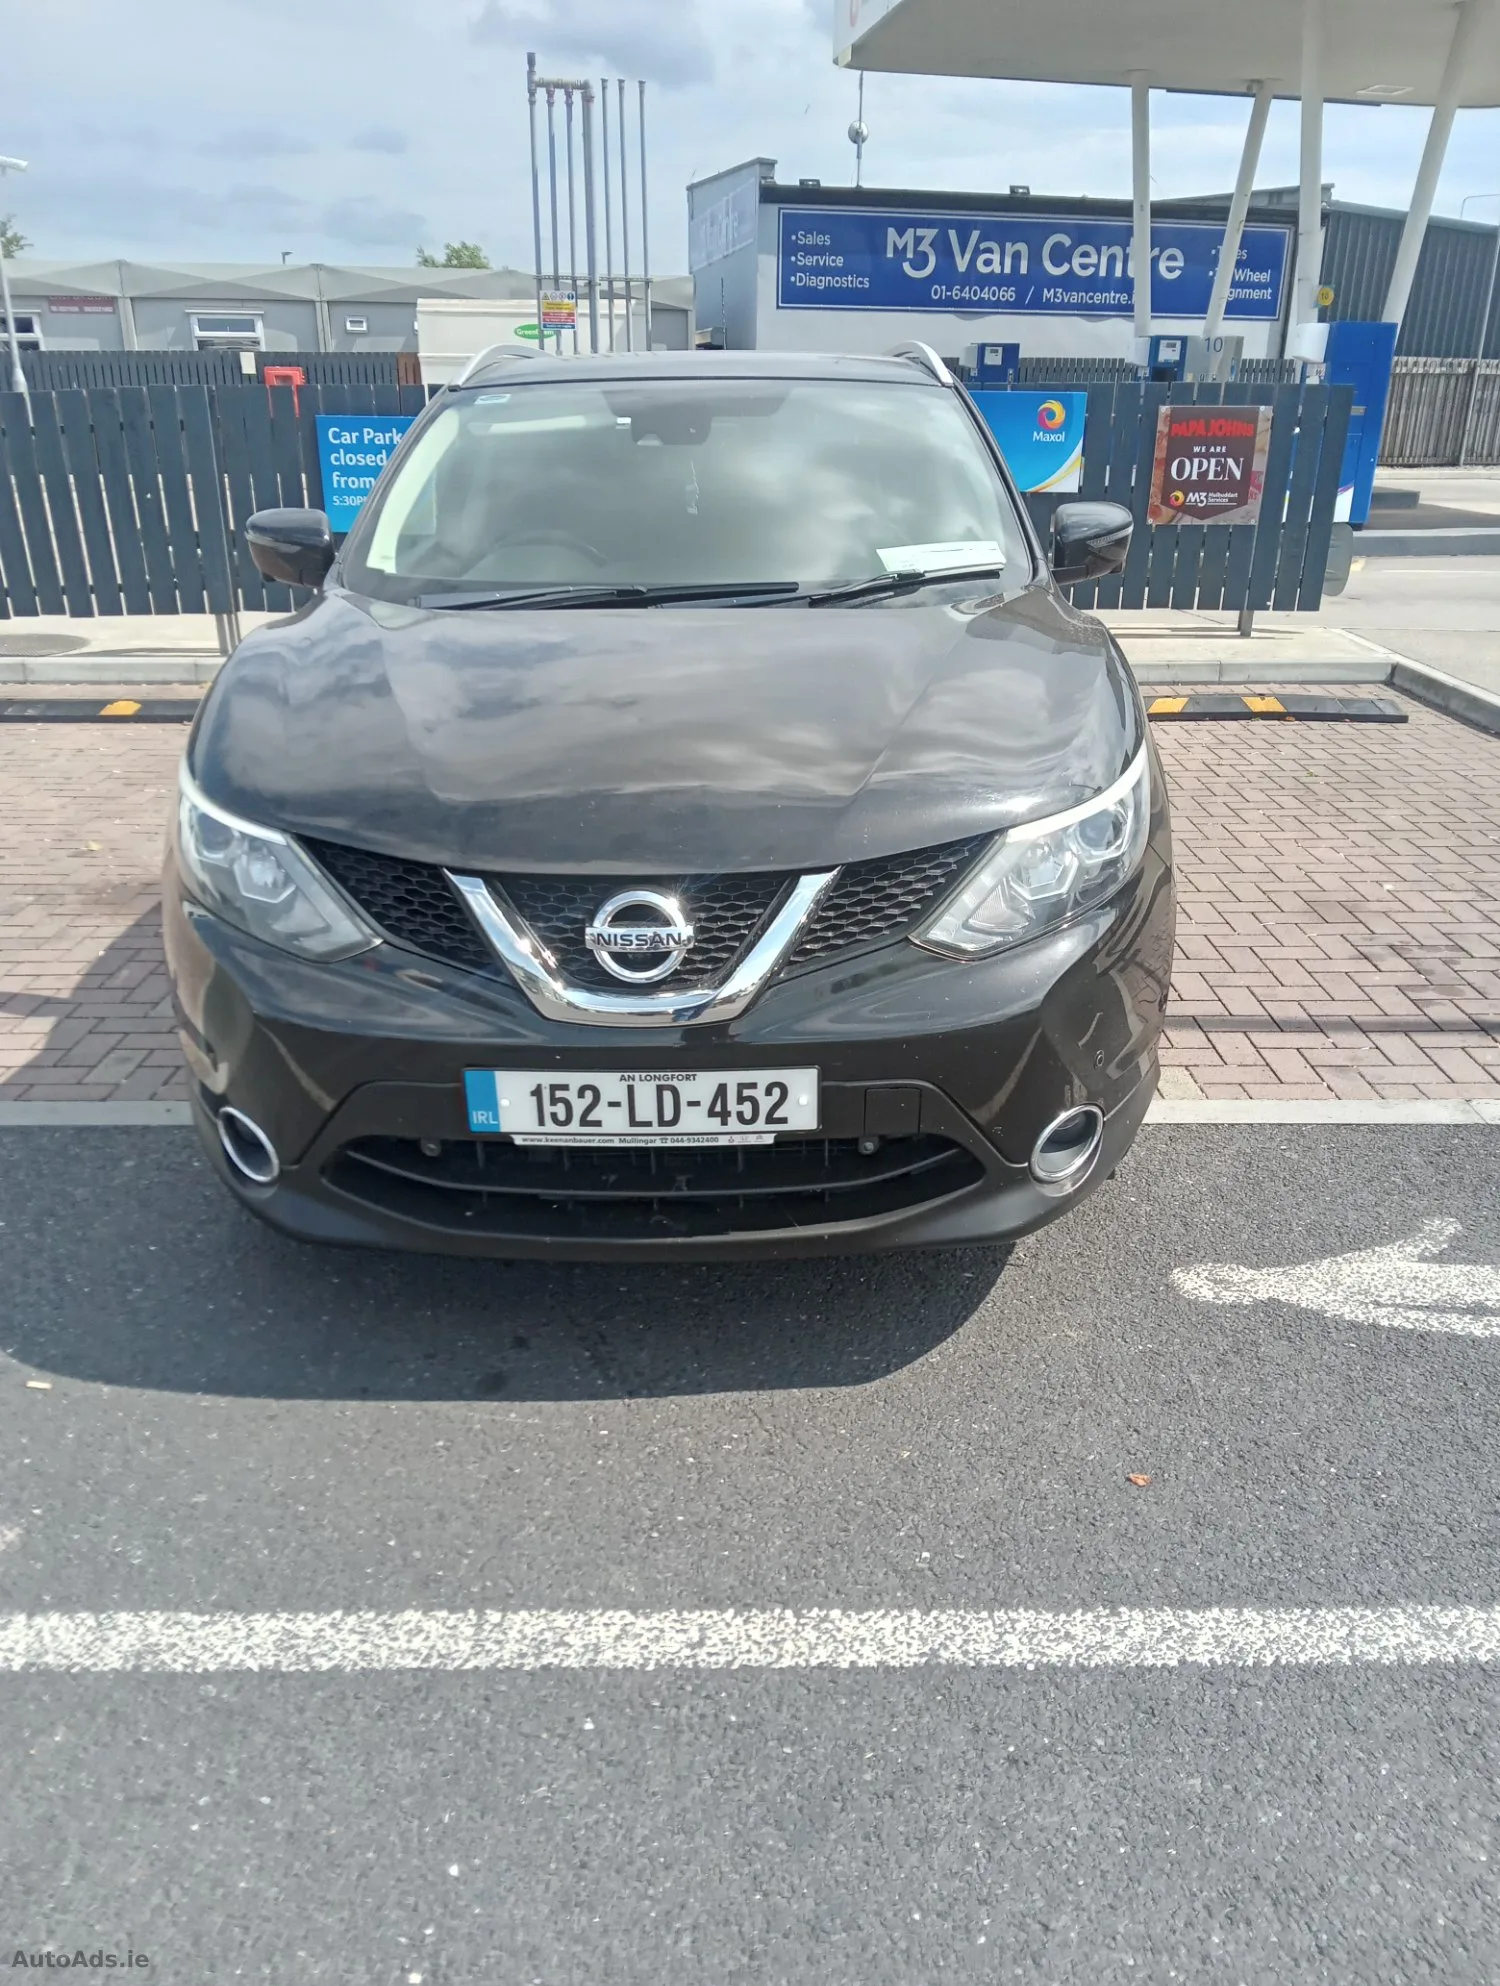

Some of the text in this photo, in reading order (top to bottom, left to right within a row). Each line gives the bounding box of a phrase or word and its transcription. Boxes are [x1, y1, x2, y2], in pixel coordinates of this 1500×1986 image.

[797, 231, 831, 245] Sales
[796, 252, 844, 267] Service
[886, 227, 939, 278] M3
[948, 229, 1029, 274] Van
[795, 272, 870, 289] Diagnostics
[1234, 268, 1271, 282] Wheel
[931, 285, 1016, 301] 01-6404066
[1042, 288, 1136, 304] M3vancentre.i
[1227, 287, 1272, 300] gnment
[1205, 337, 1224, 353] 10
[1171, 418, 1207, 437] PAPA
[328, 427, 402, 445] Car Park
[1032, 431, 1066, 442] Maxol
[1193, 445, 1227, 453] WE ARE
[330, 448, 387, 466] closed
[1170, 456, 1245, 481] OPEN
[332, 471, 376, 489] from
[332, 495, 367, 506] 5:30P
[1186, 491, 1208, 507] M3
[596, 932, 682, 947] NISSAN
[619, 1073, 698, 1082] AN LONGFORT
[529, 1081, 789, 1128] 152-LD-452
[472, 1110, 499, 1125] IRL
[618, 1137, 657, 1145] Mullingar
